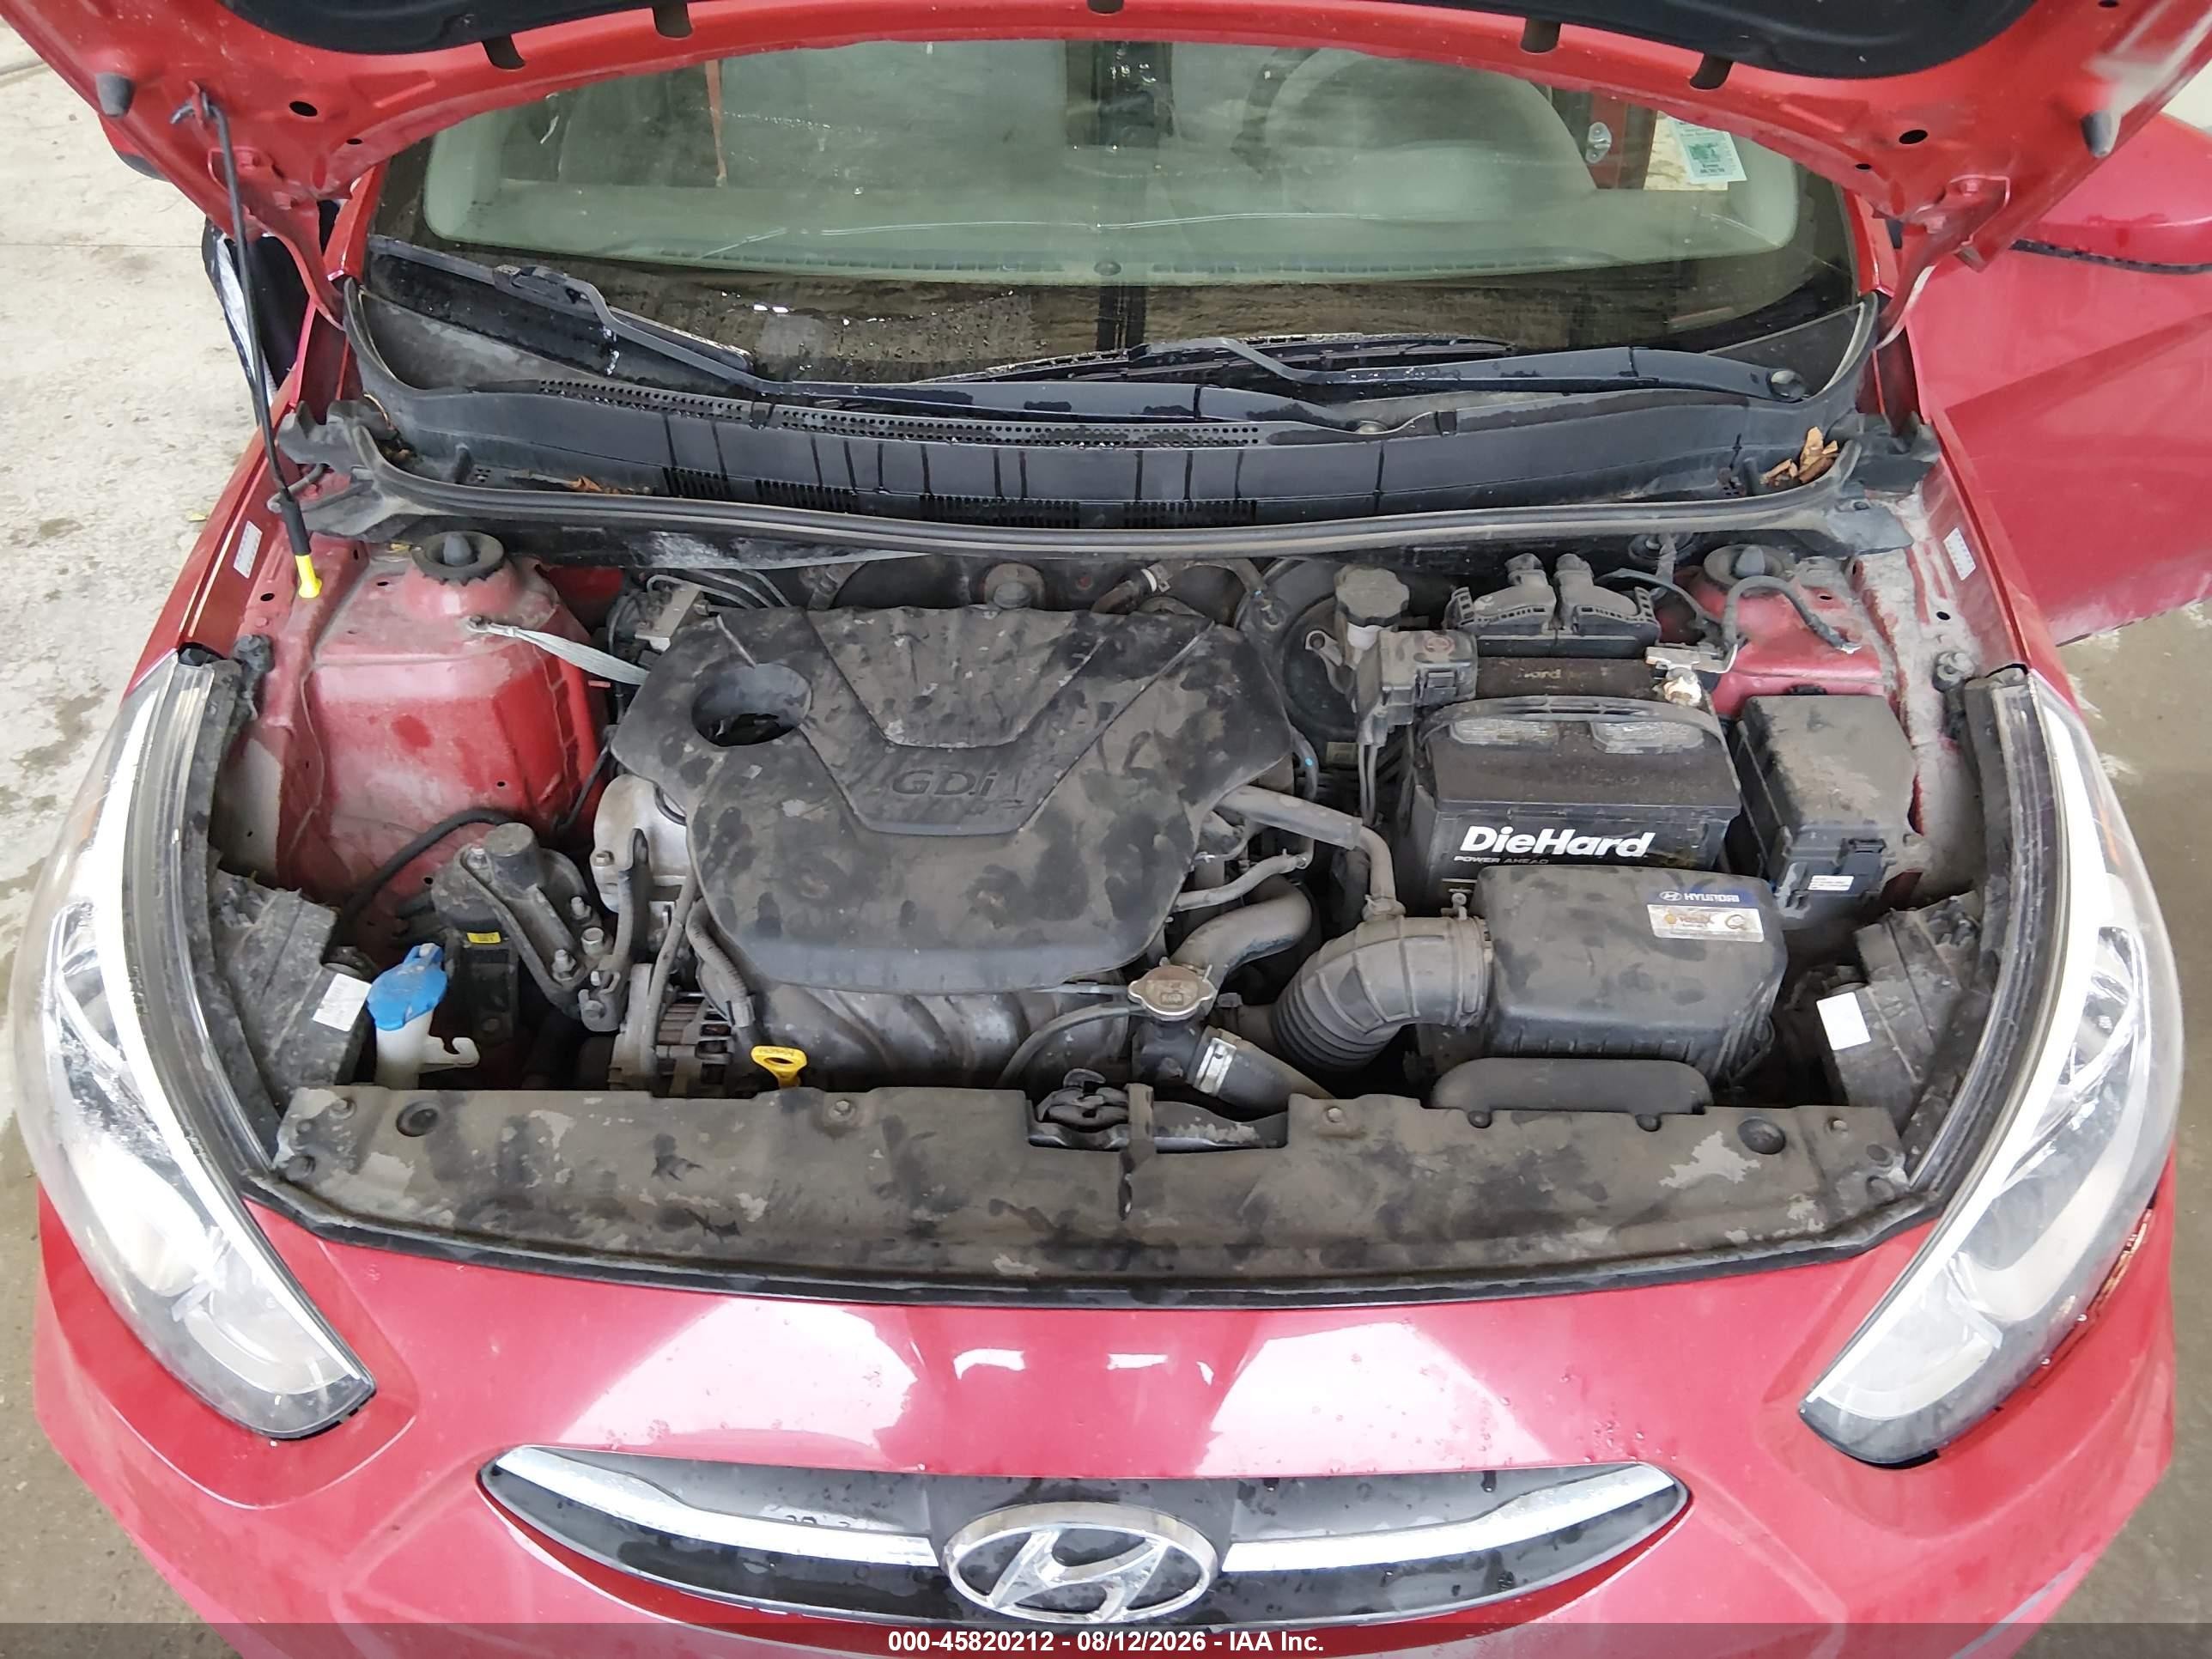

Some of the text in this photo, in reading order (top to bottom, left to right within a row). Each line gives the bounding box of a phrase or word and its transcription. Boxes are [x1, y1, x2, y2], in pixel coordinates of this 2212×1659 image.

[1460, 825, 1656, 858] DieHard
[1454, 854, 1501, 864] POWER
[1684, 892, 1741, 903] HYUNDAI
